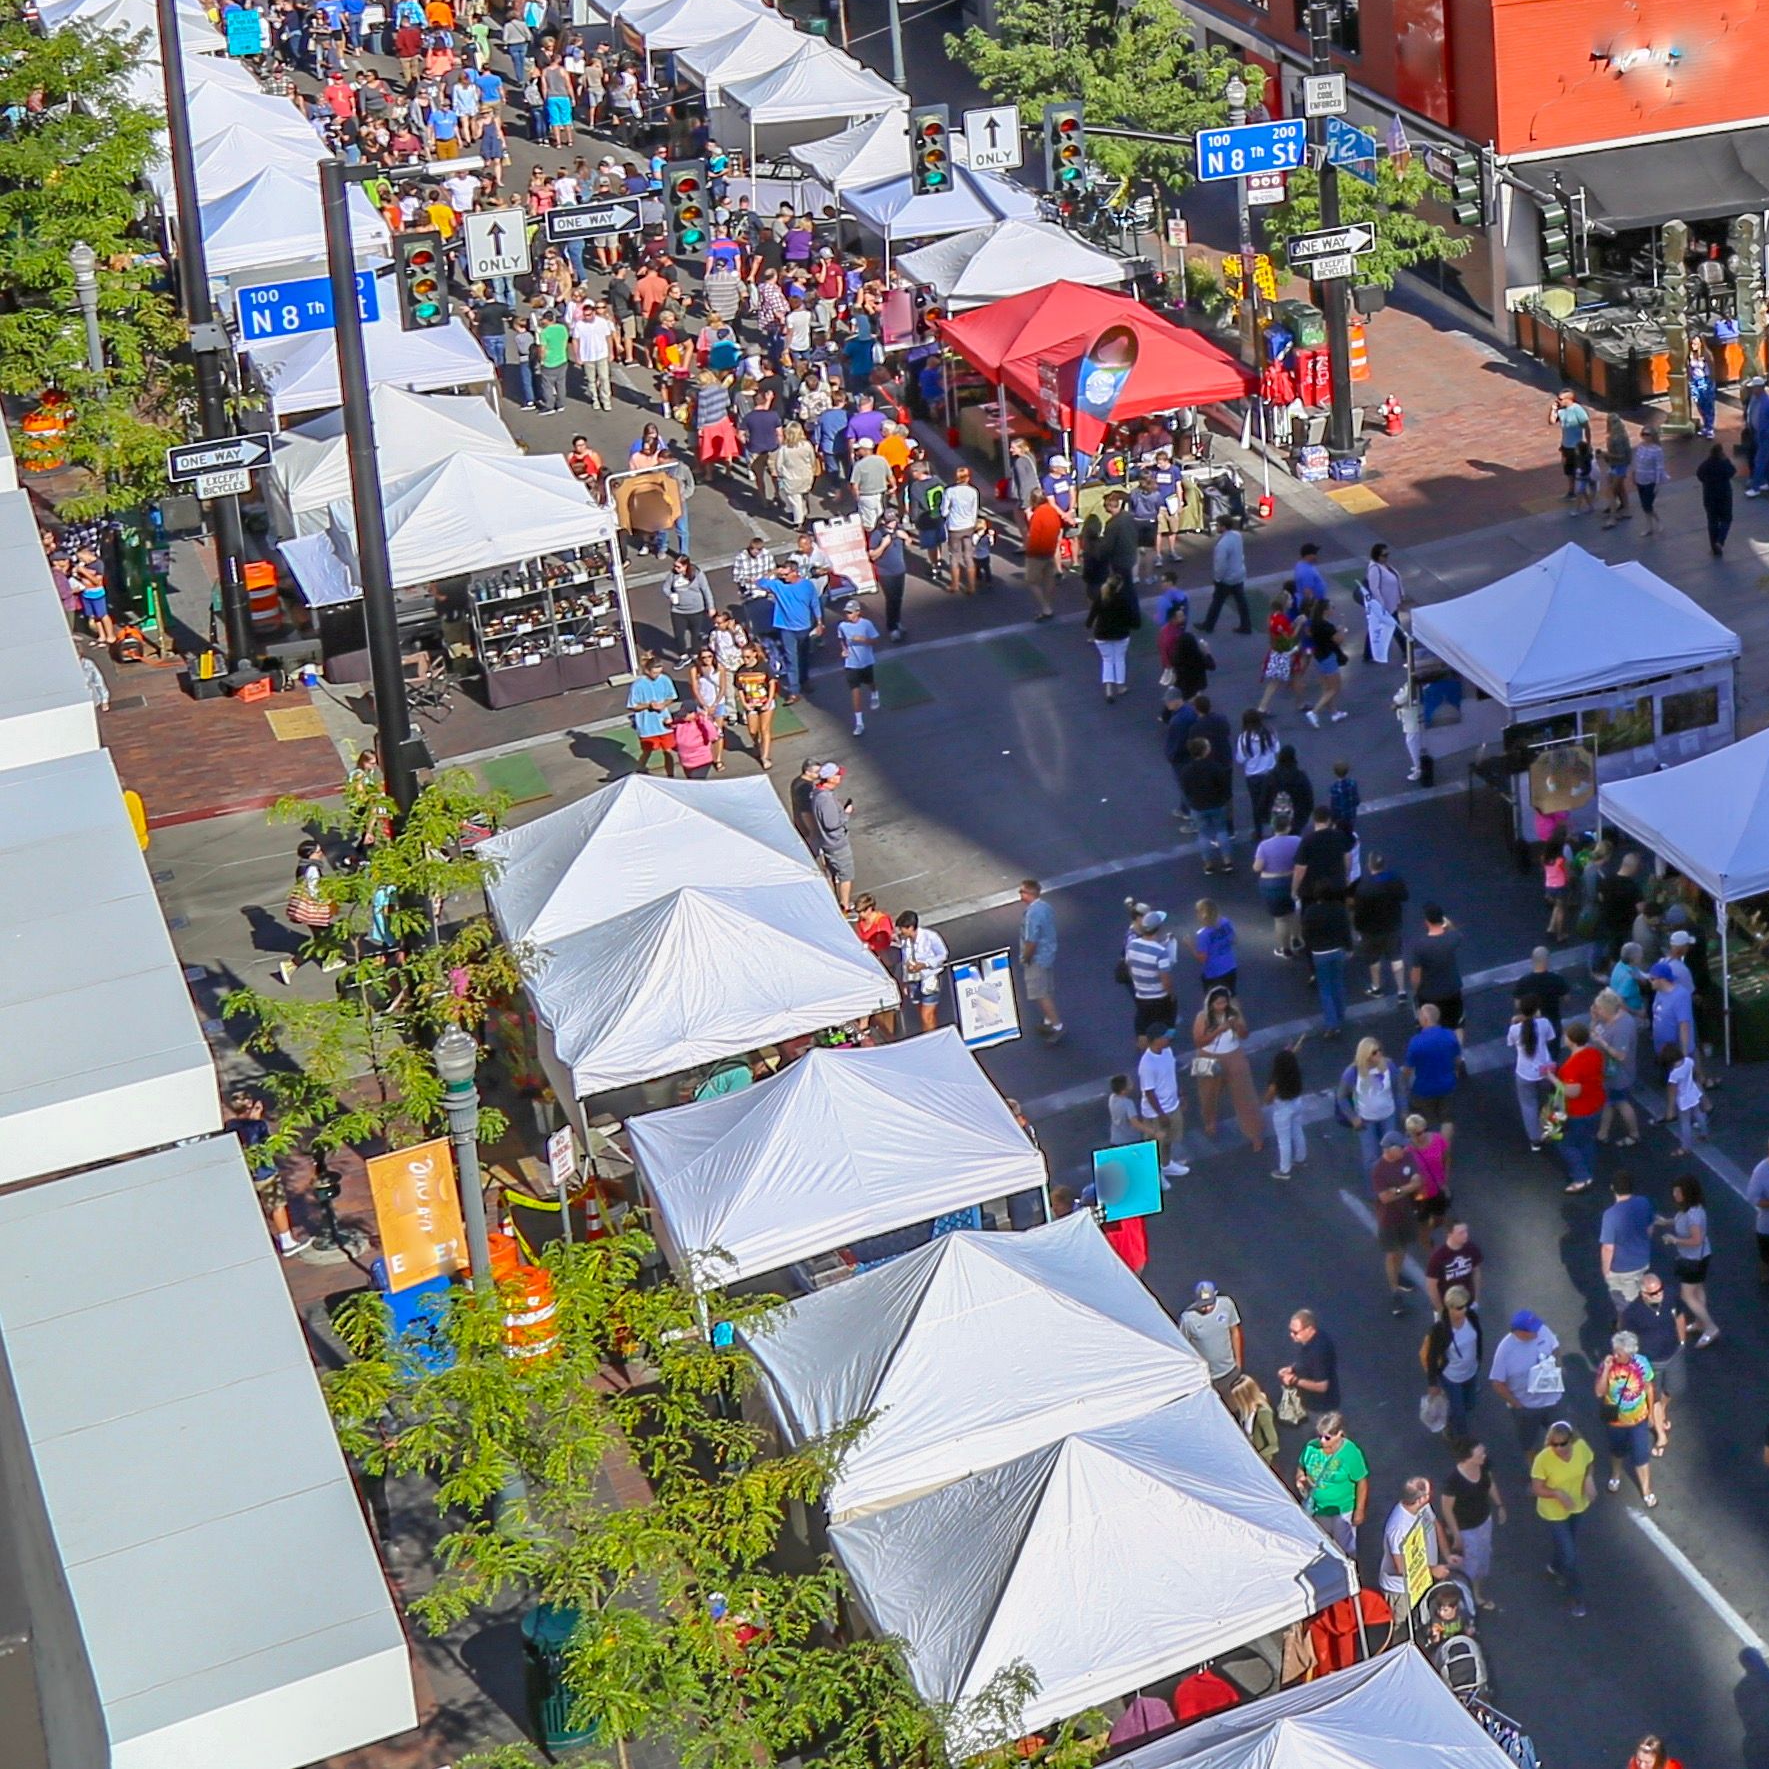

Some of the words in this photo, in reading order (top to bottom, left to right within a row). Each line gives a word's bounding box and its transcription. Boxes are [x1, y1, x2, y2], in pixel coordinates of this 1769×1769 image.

[1207, 134, 1231, 148] 100
[1272, 125, 1296, 140] 200
[975, 150, 1012, 166] ONLY
[1207, 151, 1223, 175] N
[1231, 149, 1245, 171] 8
[1249, 146, 1265, 159] Th
[1272, 141, 1298, 166] St
[557, 217, 583, 230] ONE
[589, 212, 613, 225] WAY
[1292, 240, 1319, 255] ONE
[1321, 235, 1347, 250] WAY
[478, 255, 522, 274] ONLY
[1319, 258, 1345, 270] EXCEPT
[250, 289, 280, 305] 100
[252, 309, 273, 335] N
[281, 305, 300, 330] 8
[306, 300, 326, 316] Th
[180, 454, 207, 468] ONE
[214, 449, 241, 462] WAY
[205, 471, 240, 486] EXCEPT
[202, 481, 246, 497] BICYCLES
